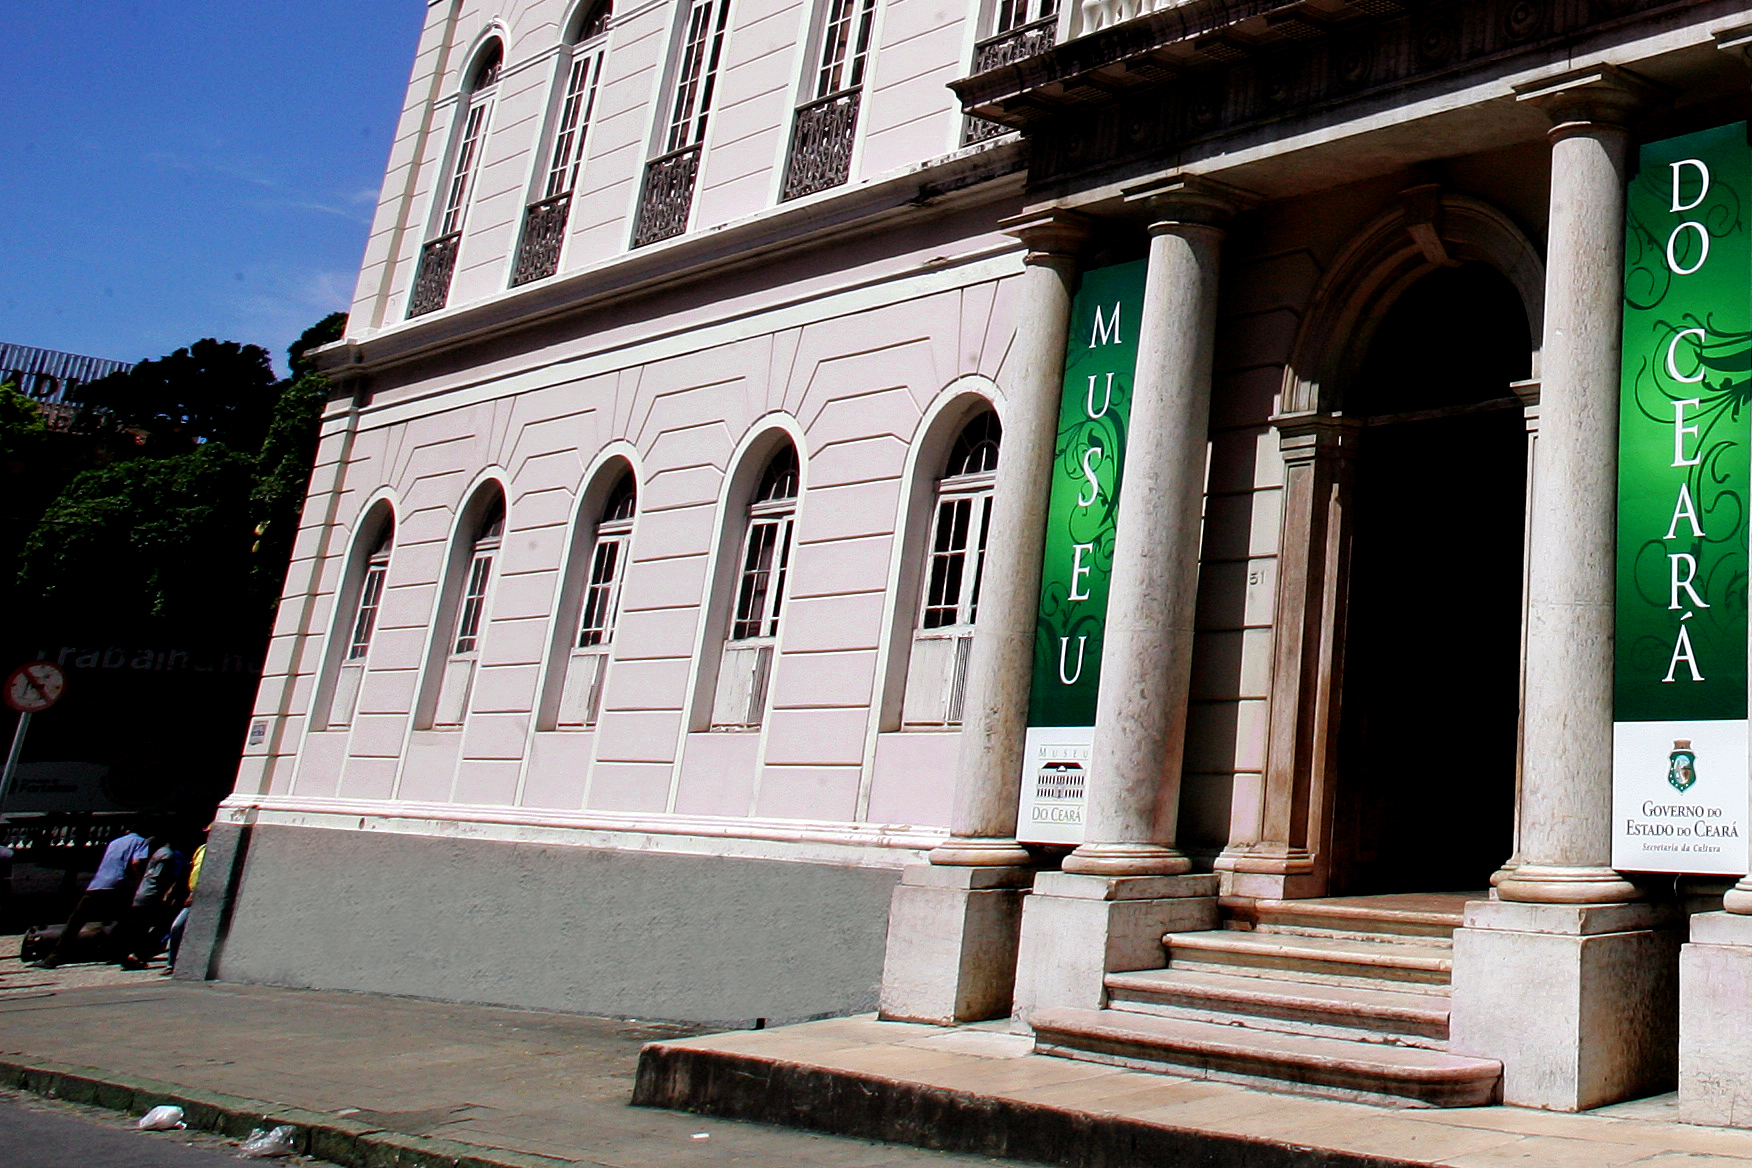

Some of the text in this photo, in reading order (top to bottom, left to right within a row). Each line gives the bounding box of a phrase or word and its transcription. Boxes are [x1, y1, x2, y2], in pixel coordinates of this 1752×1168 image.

[1661, 157, 1711, 684] DO CEARÁ
[1058, 300, 1122, 686] MUSEU
[1050, 806, 1082, 823] CEARÁ
[1642, 800, 1704, 817] GOVERNO
[1626, 819, 1674, 837] ESTADO
[1694, 820, 1739, 838] CEARÁ
[1642, 842, 1721, 853] Secretaria da Cultura
